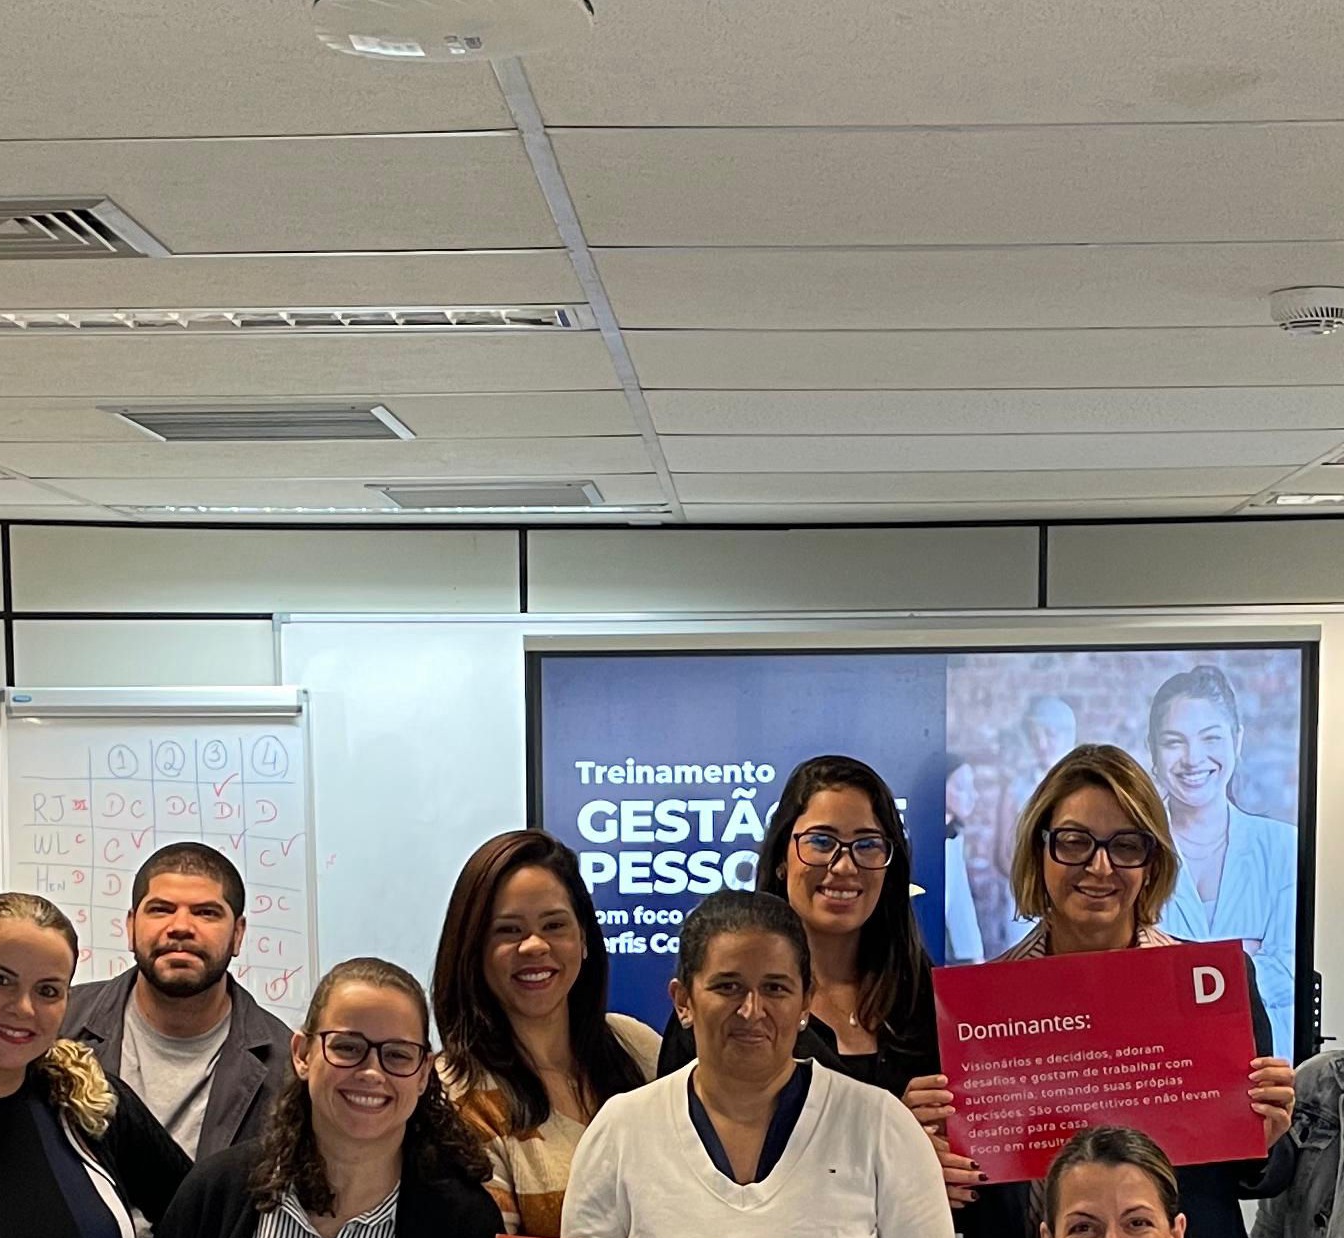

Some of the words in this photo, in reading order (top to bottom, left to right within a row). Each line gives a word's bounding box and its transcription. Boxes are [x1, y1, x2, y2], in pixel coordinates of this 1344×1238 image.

[575, 758, 776, 784] Treinamento
[577, 787, 778, 844] GESTÃ
[580, 850, 759, 895] PESSO
[597, 908, 628, 925] om
[633, 905, 683, 925] foco
[603, 932, 647, 954] erfis
[1193, 966, 1225, 1004] D
[958, 1012, 1092, 1042] Dominantes:
[962, 1058, 1031, 1071] Visionários
[1116, 1045, 1164, 1057] adoram
[964, 1076, 1015, 1089] desafios
[1031, 1071, 1078, 1084] gostam
[1083, 1068, 1098, 1076] de
[1103, 1062, 1162, 1075] trabalhar
[1165, 1060, 1192, 1069] com
[1029, 1106, 1051, 1116] São
[1056, 1098, 1139, 1113] competitivos
[1143, 1097, 1150, 1105] e
[1155, 1093, 1178, 1103] não
[1182, 1090, 1220, 1101] levam
[1042, 1084, 1099, 1098] tomando
[1104, 1082, 1131, 1092] suas
[968, 1126, 1023, 1138] desaforo
[1028, 1123, 1056, 1134] para
[1005, 1143, 1024, 1151] em
